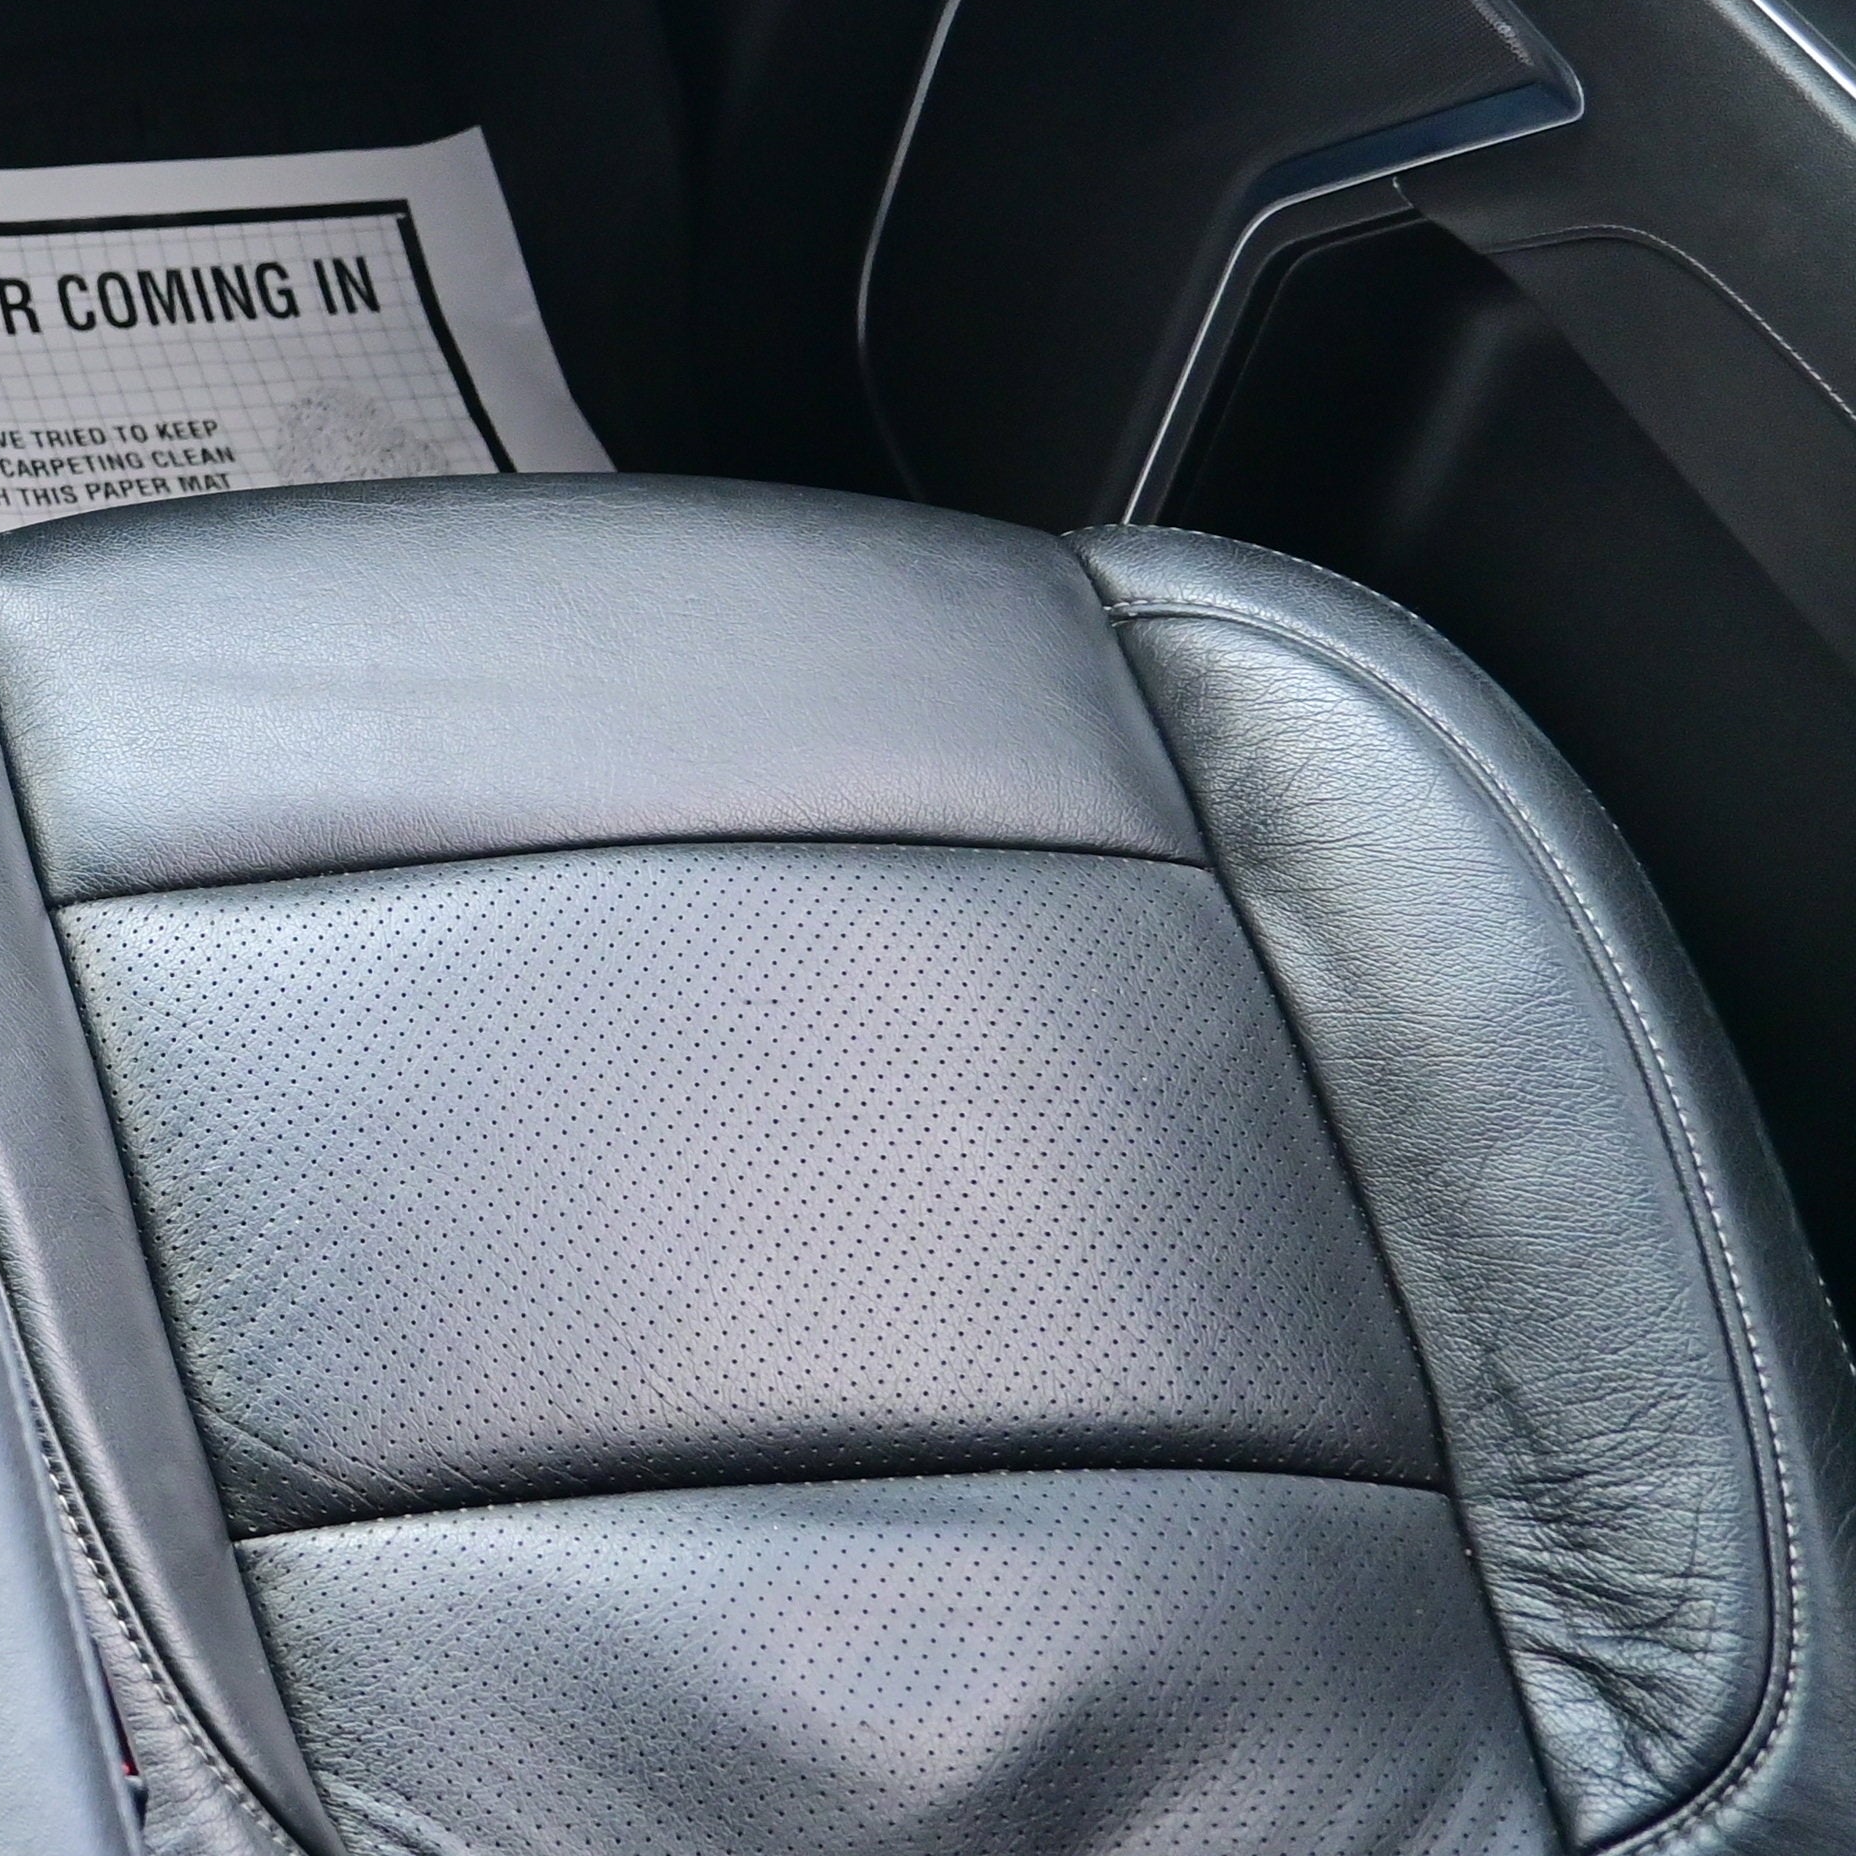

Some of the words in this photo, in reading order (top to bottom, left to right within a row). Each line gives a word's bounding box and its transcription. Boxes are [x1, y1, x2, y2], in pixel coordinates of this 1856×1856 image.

[56, 260, 301, 334] COMING
[312, 255, 382, 315] IN
[31, 426, 108, 450] TRIED
[113, 423, 149, 445] TO
[155, 418, 219, 442] KEEP
[0, 451, 145, 479] CARPETING
[151, 445, 237, 469] CLEAN
[17, 482, 79, 507] THIS
[84, 476, 172, 502] PAPER
[178, 471, 233, 494] MAT
